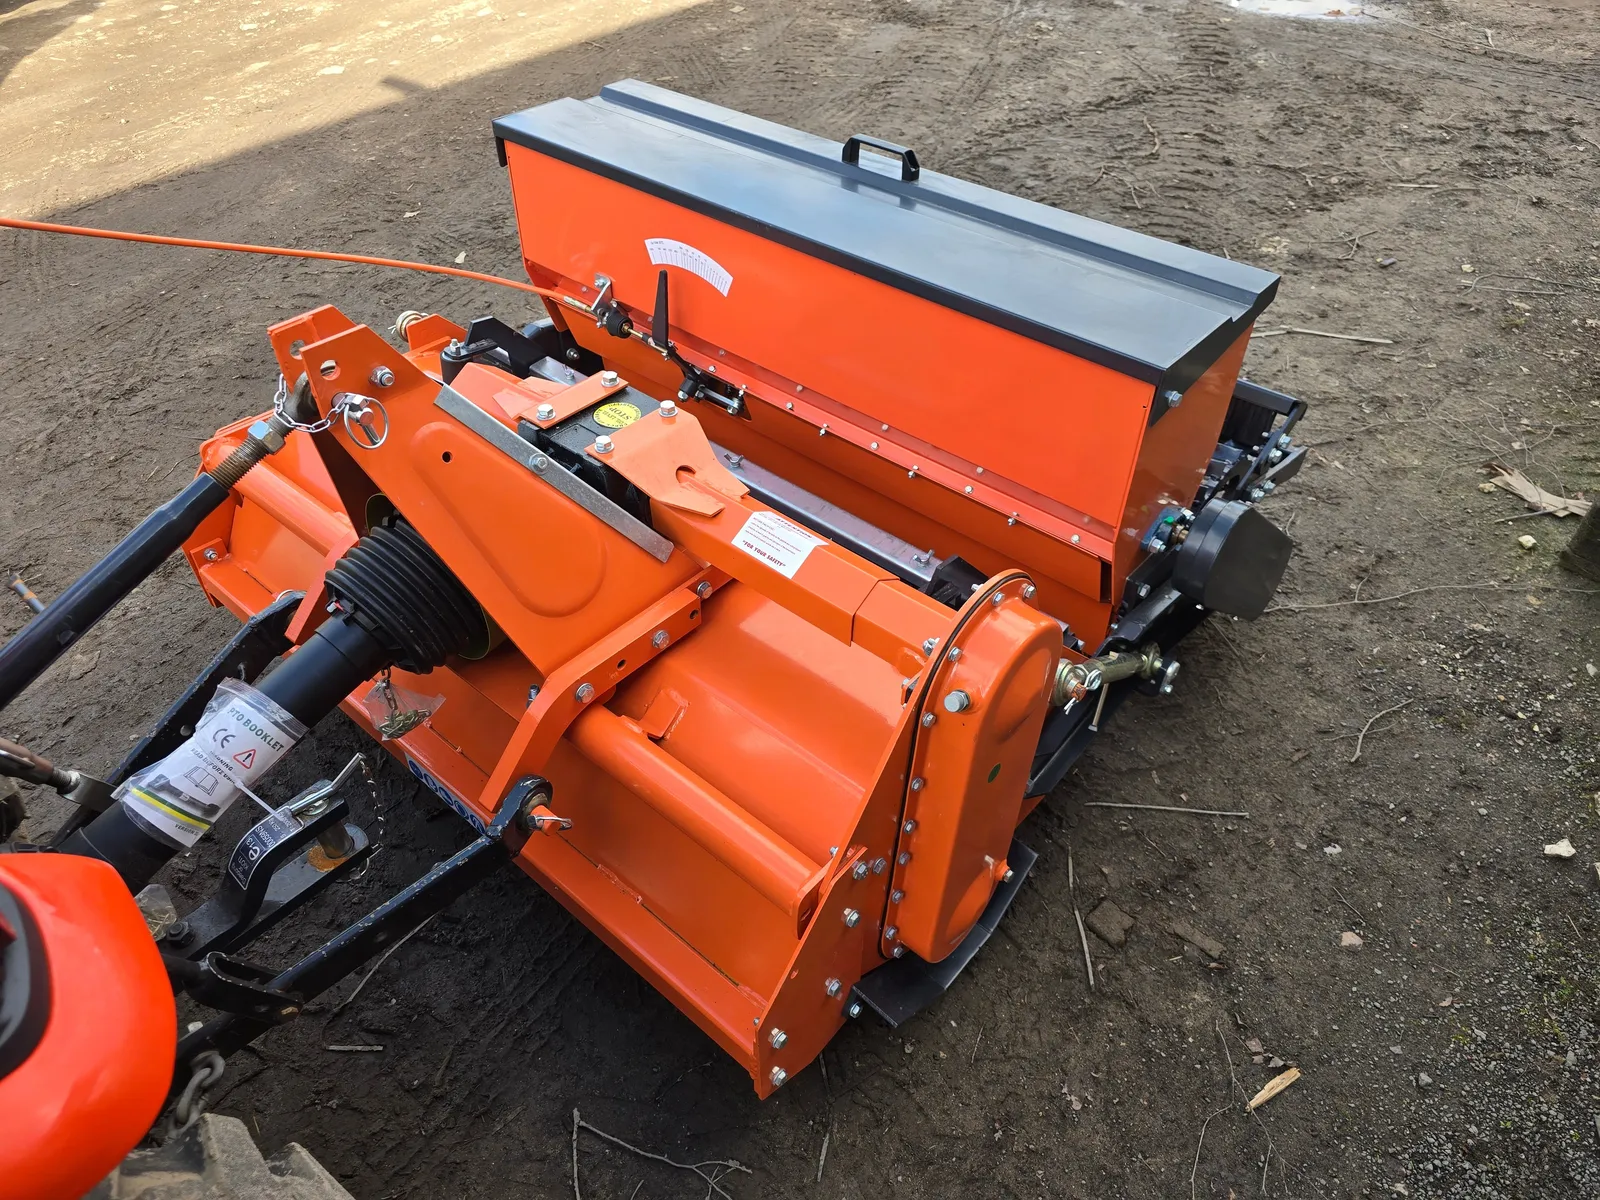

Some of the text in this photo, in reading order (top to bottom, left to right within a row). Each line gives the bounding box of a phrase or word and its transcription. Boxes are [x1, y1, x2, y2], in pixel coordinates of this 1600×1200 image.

[609, 407, 632, 420] STOP
[754, 547, 767, 557] YOUR
[227, 707, 285, 752] PTO BOOKLET
[213, 728, 236, 749] CE
[255, 826, 276, 847] 00059NS
[238, 856, 249, 870] KIOTI
